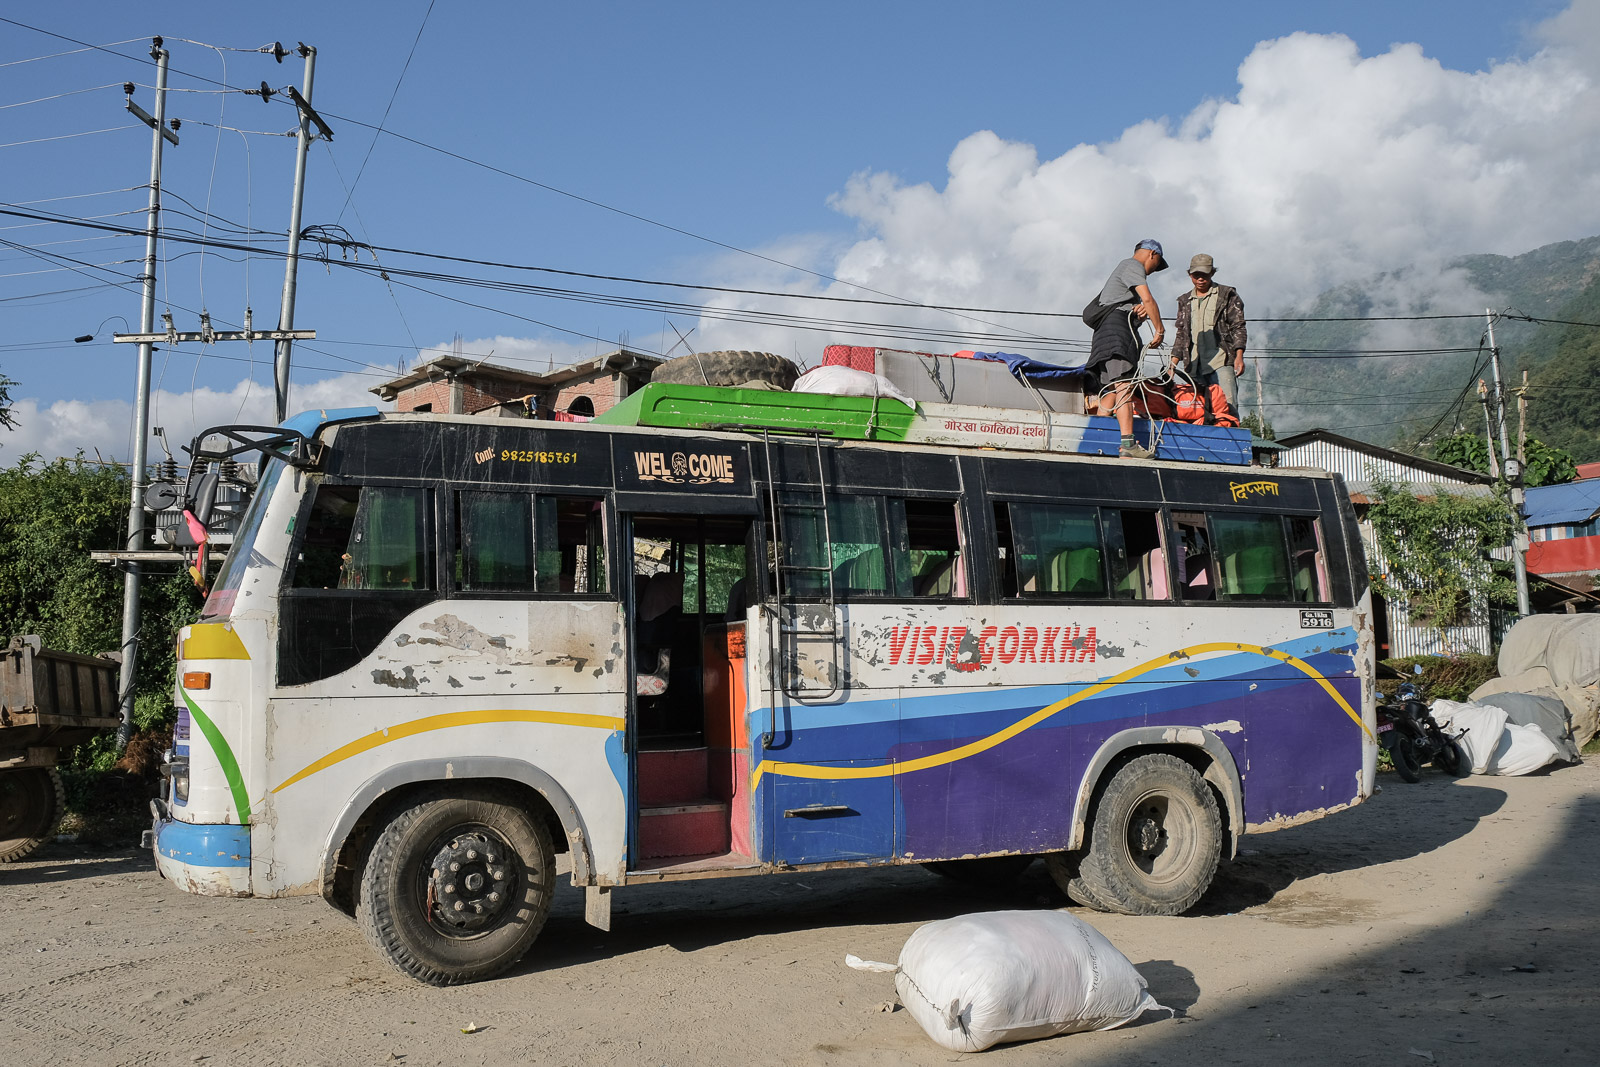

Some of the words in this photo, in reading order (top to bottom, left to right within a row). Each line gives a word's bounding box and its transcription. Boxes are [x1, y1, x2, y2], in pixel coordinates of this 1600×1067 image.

[1302, 618, 1332, 627] 5916
[888, 625, 968, 665] VISIT
[979, 625, 1098, 665] GORKHA
